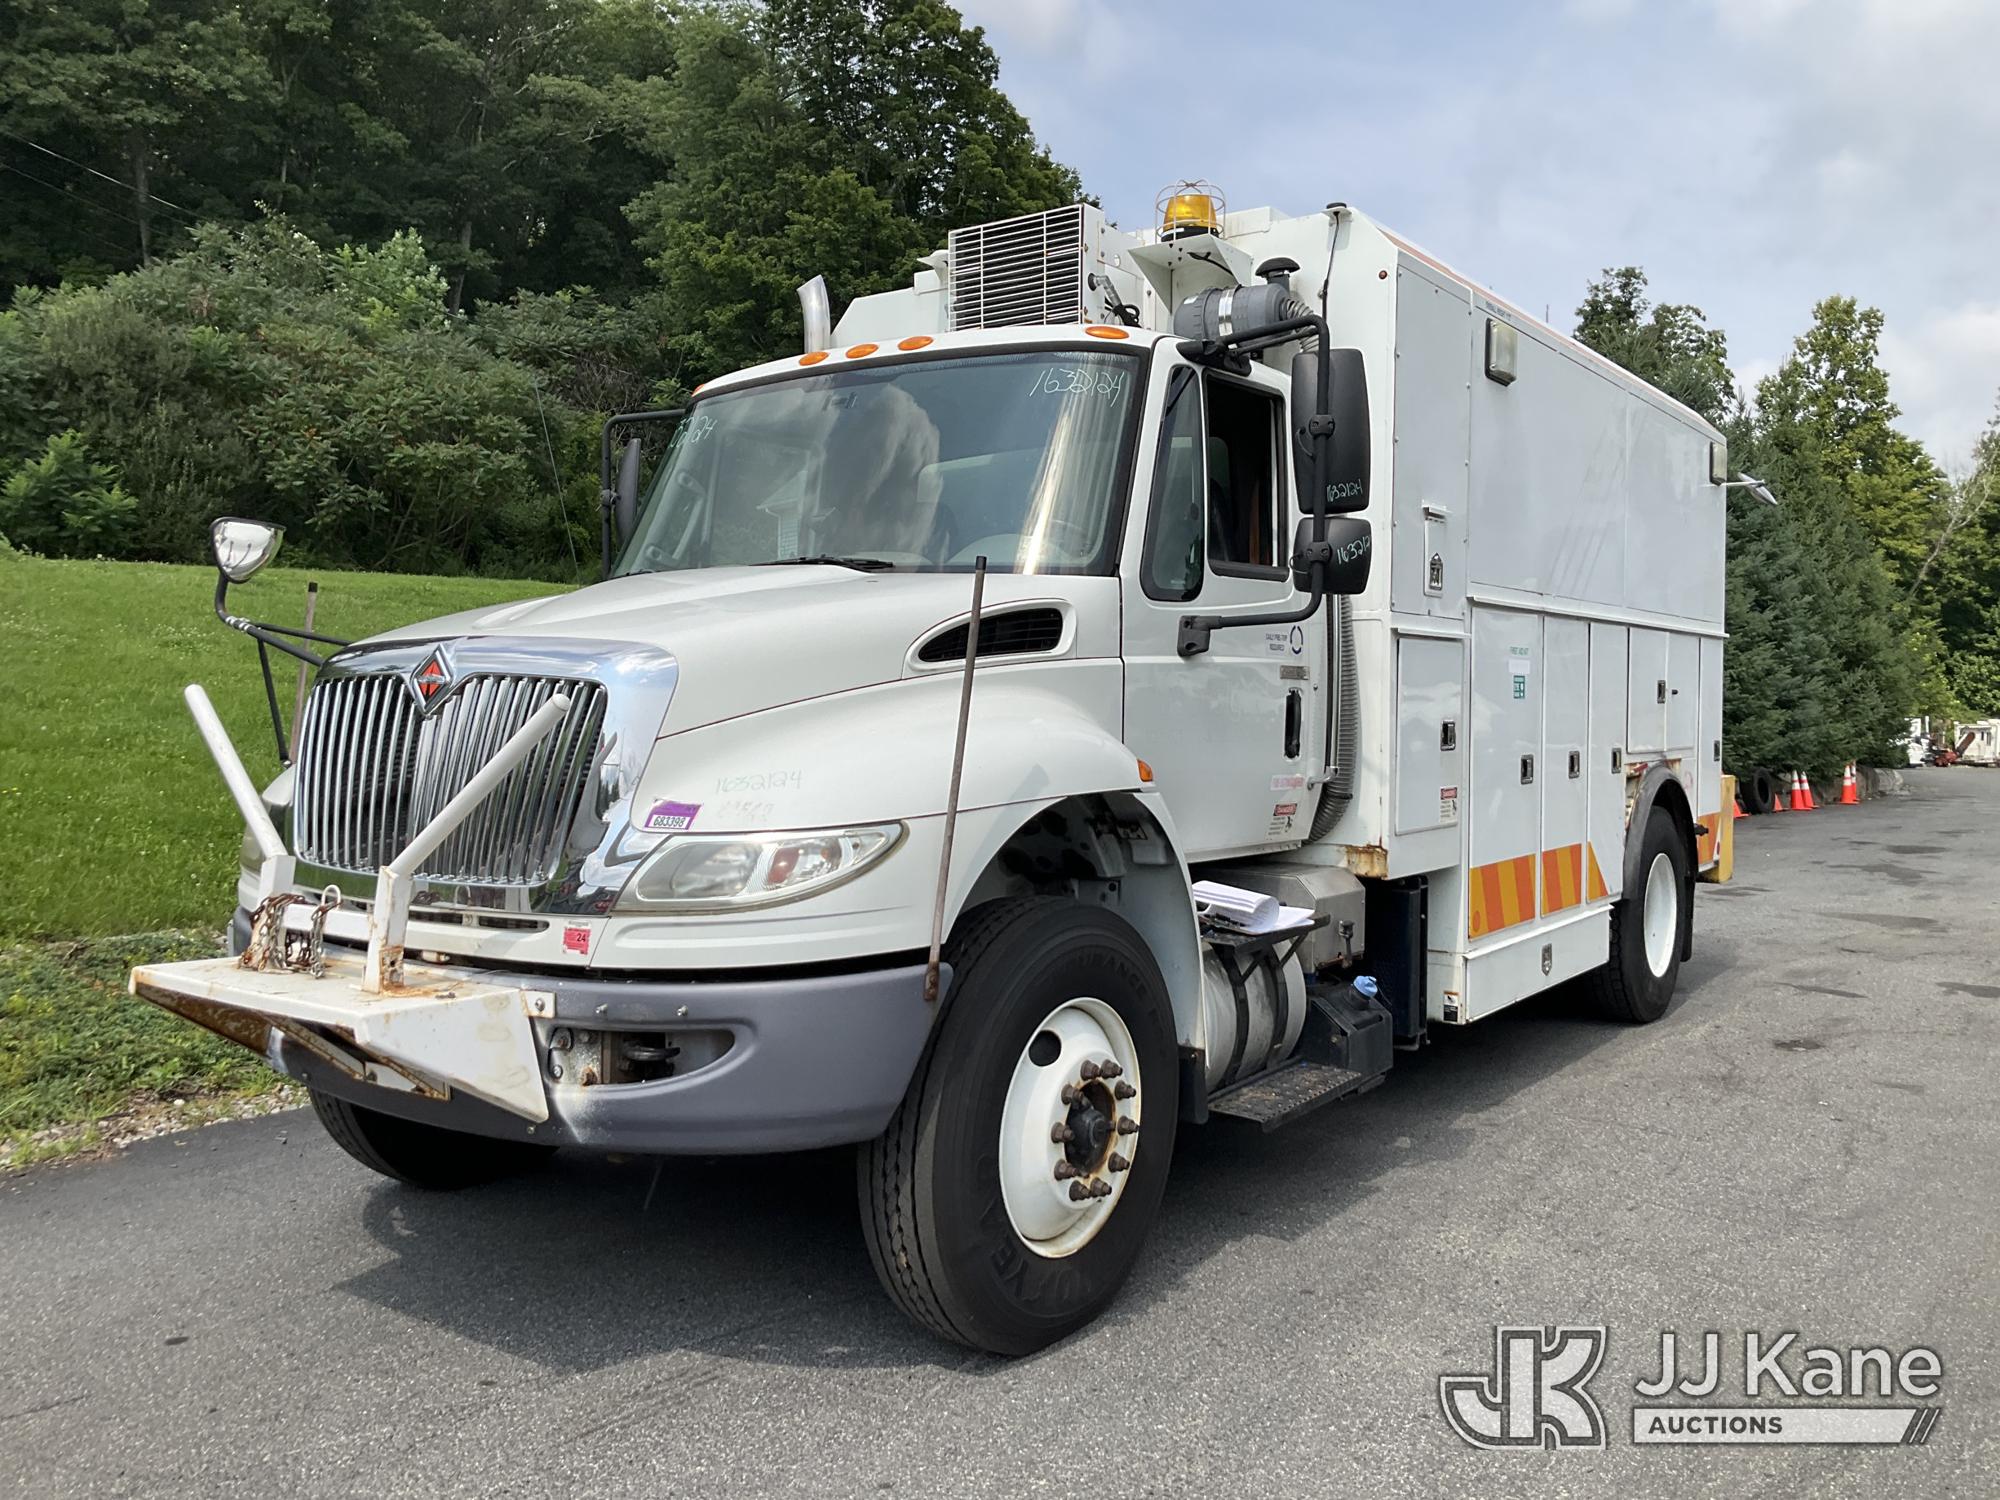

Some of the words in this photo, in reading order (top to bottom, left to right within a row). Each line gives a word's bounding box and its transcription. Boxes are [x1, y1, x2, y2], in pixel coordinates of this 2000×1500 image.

[1029, 367, 1125, 407] 1632124
[653, 815, 686, 828] 683398
[576, 932, 587, 943] 24
